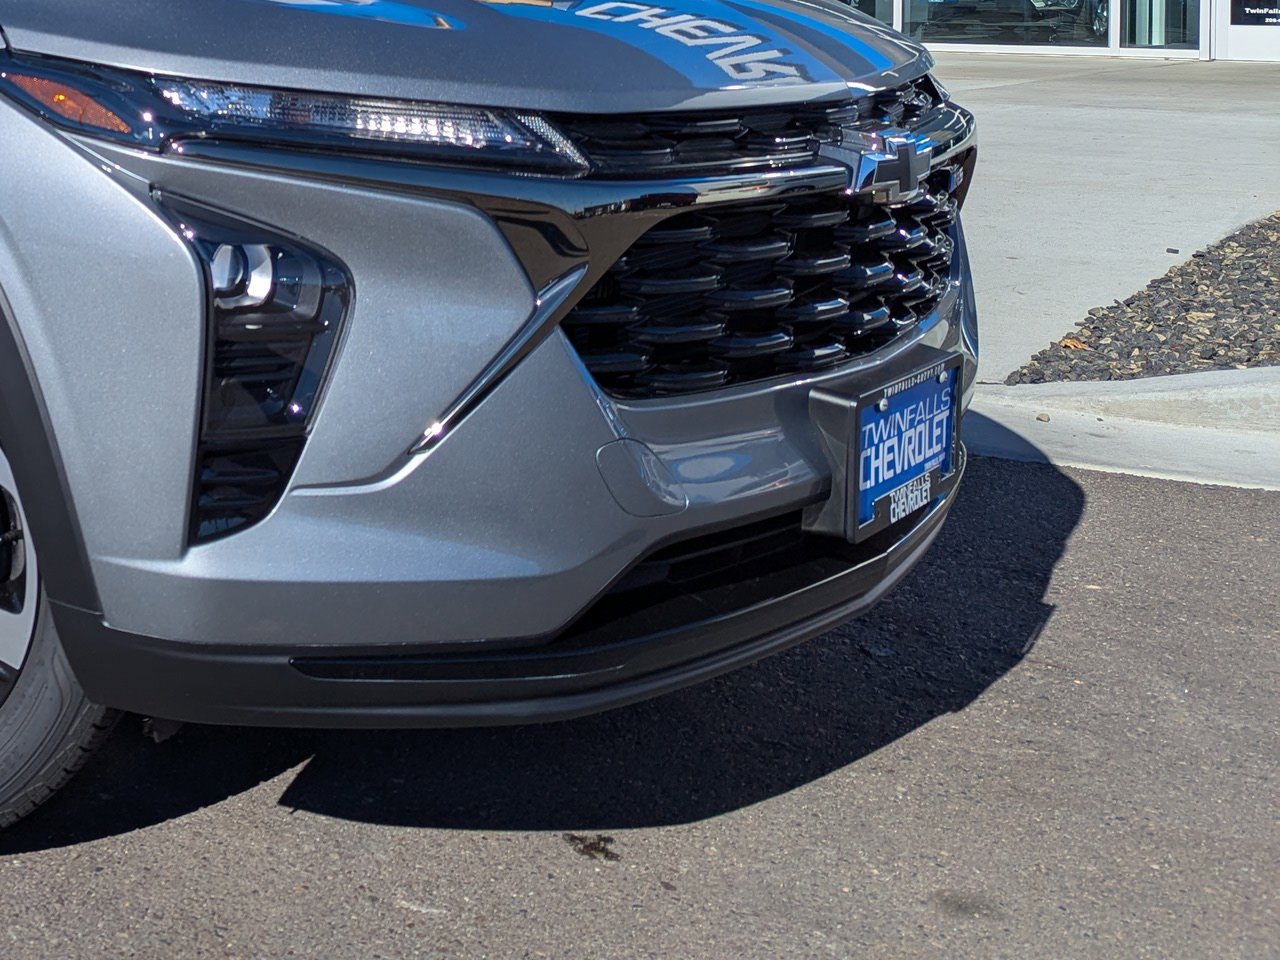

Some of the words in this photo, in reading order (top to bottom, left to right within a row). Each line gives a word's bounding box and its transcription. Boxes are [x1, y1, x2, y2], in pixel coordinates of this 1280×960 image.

[862, 387, 951, 448] TWINFALLS
[859, 409, 950, 490] CHEVROLET
[889, 472, 931, 502] TWINFALLS
[890, 485, 931, 523] CHEVROLET
